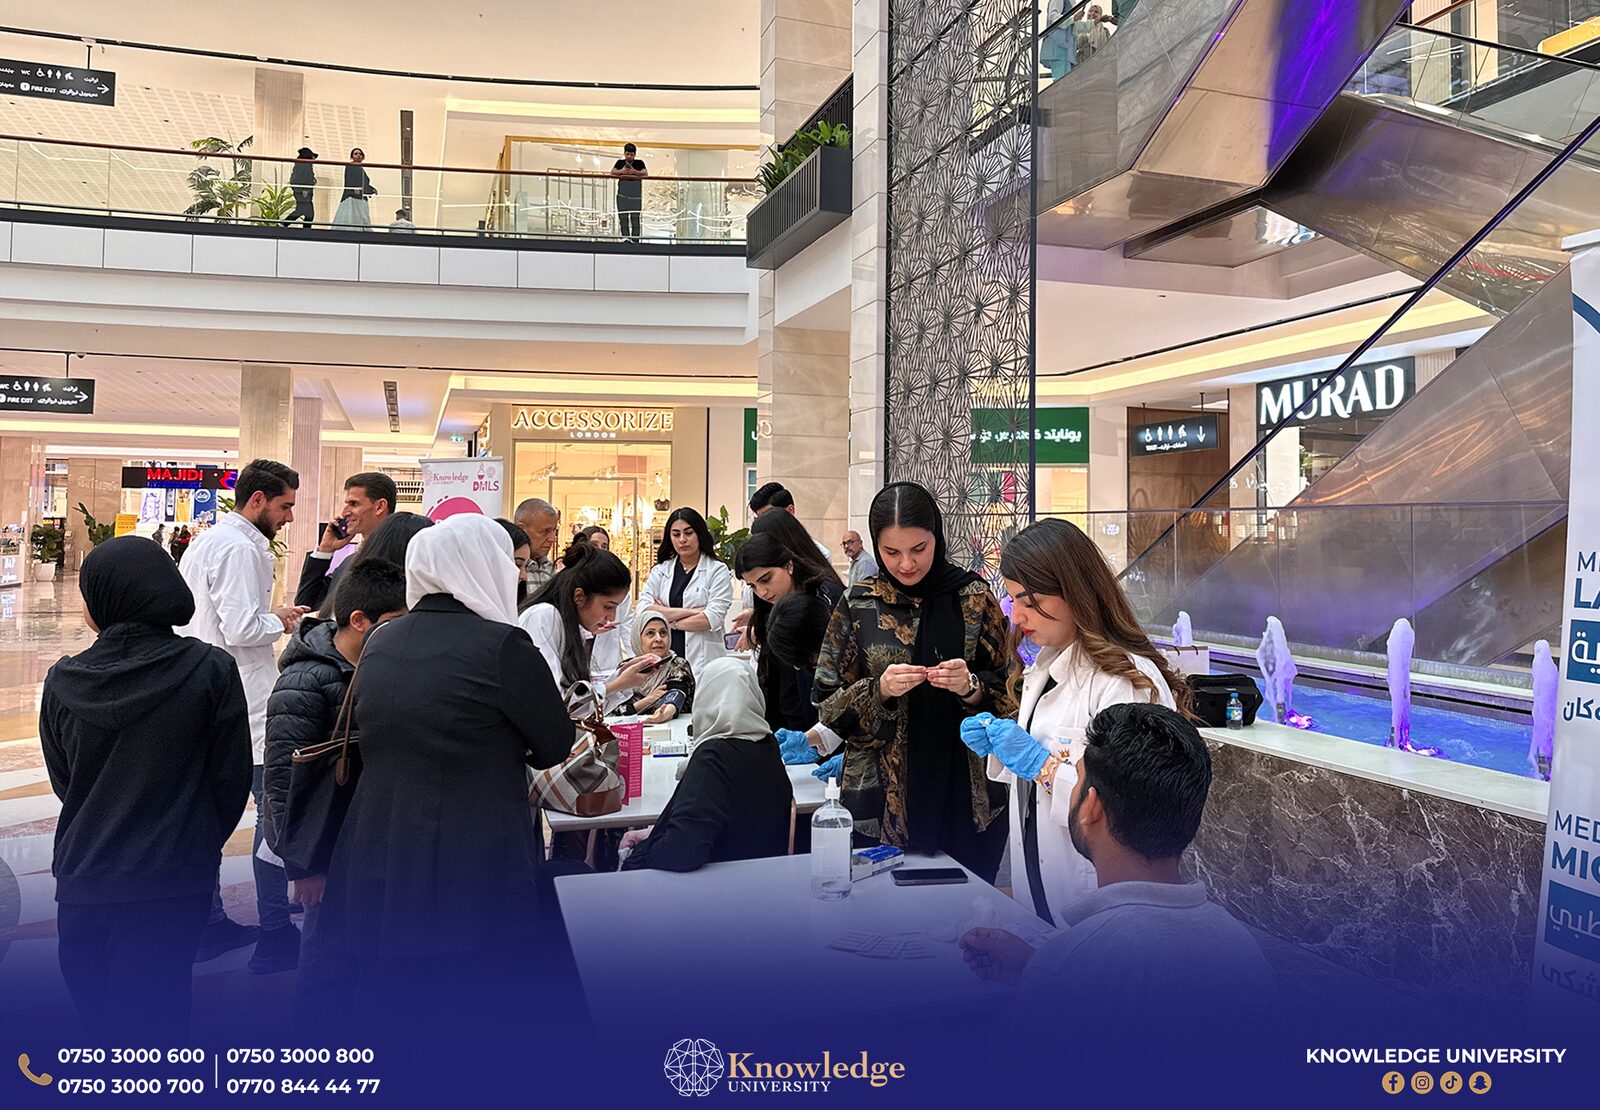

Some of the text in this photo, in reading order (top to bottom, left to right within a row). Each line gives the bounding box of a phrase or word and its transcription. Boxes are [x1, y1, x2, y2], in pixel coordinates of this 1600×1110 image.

[1260, 364, 1404, 425] MURAD
[512, 409, 673, 431] ACCESSORIZE
[570, 431, 616, 439] LONDON
[147, 467, 204, 480] MAJIDI
[433, 472, 469, 483] Knowledge
